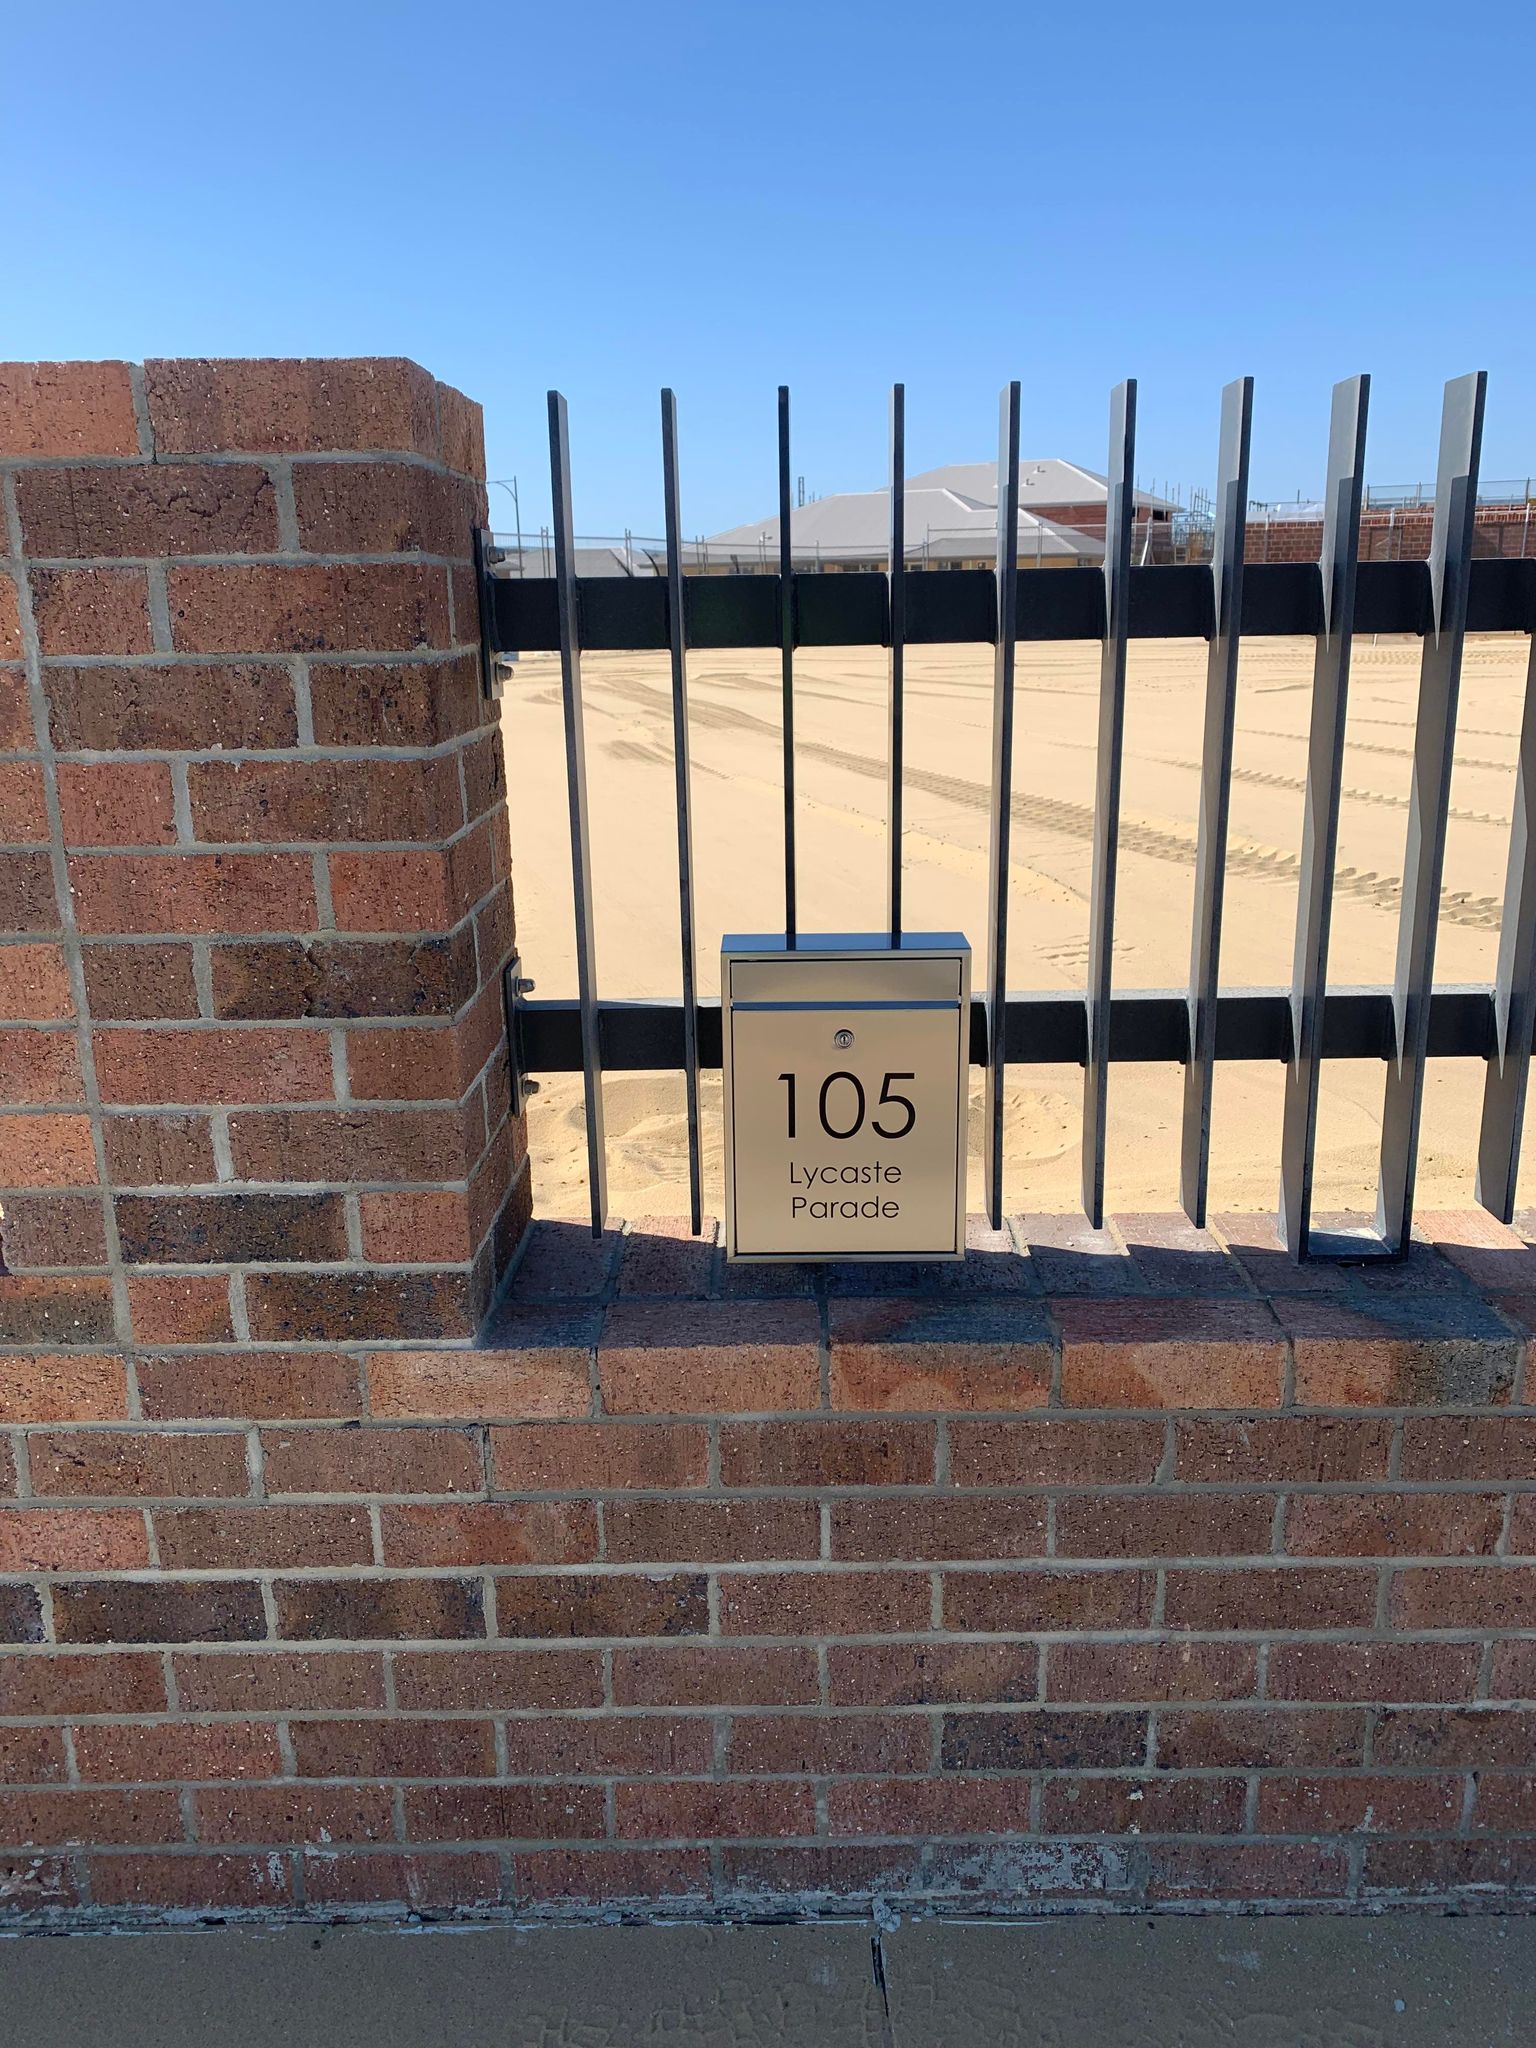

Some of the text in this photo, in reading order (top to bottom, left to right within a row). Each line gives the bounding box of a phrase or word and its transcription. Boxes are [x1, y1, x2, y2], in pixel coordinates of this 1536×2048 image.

[777, 1071, 916, 1139] 105
[790, 1161, 902, 1189] Lycaste
[792, 1196, 900, 1219] Parade
